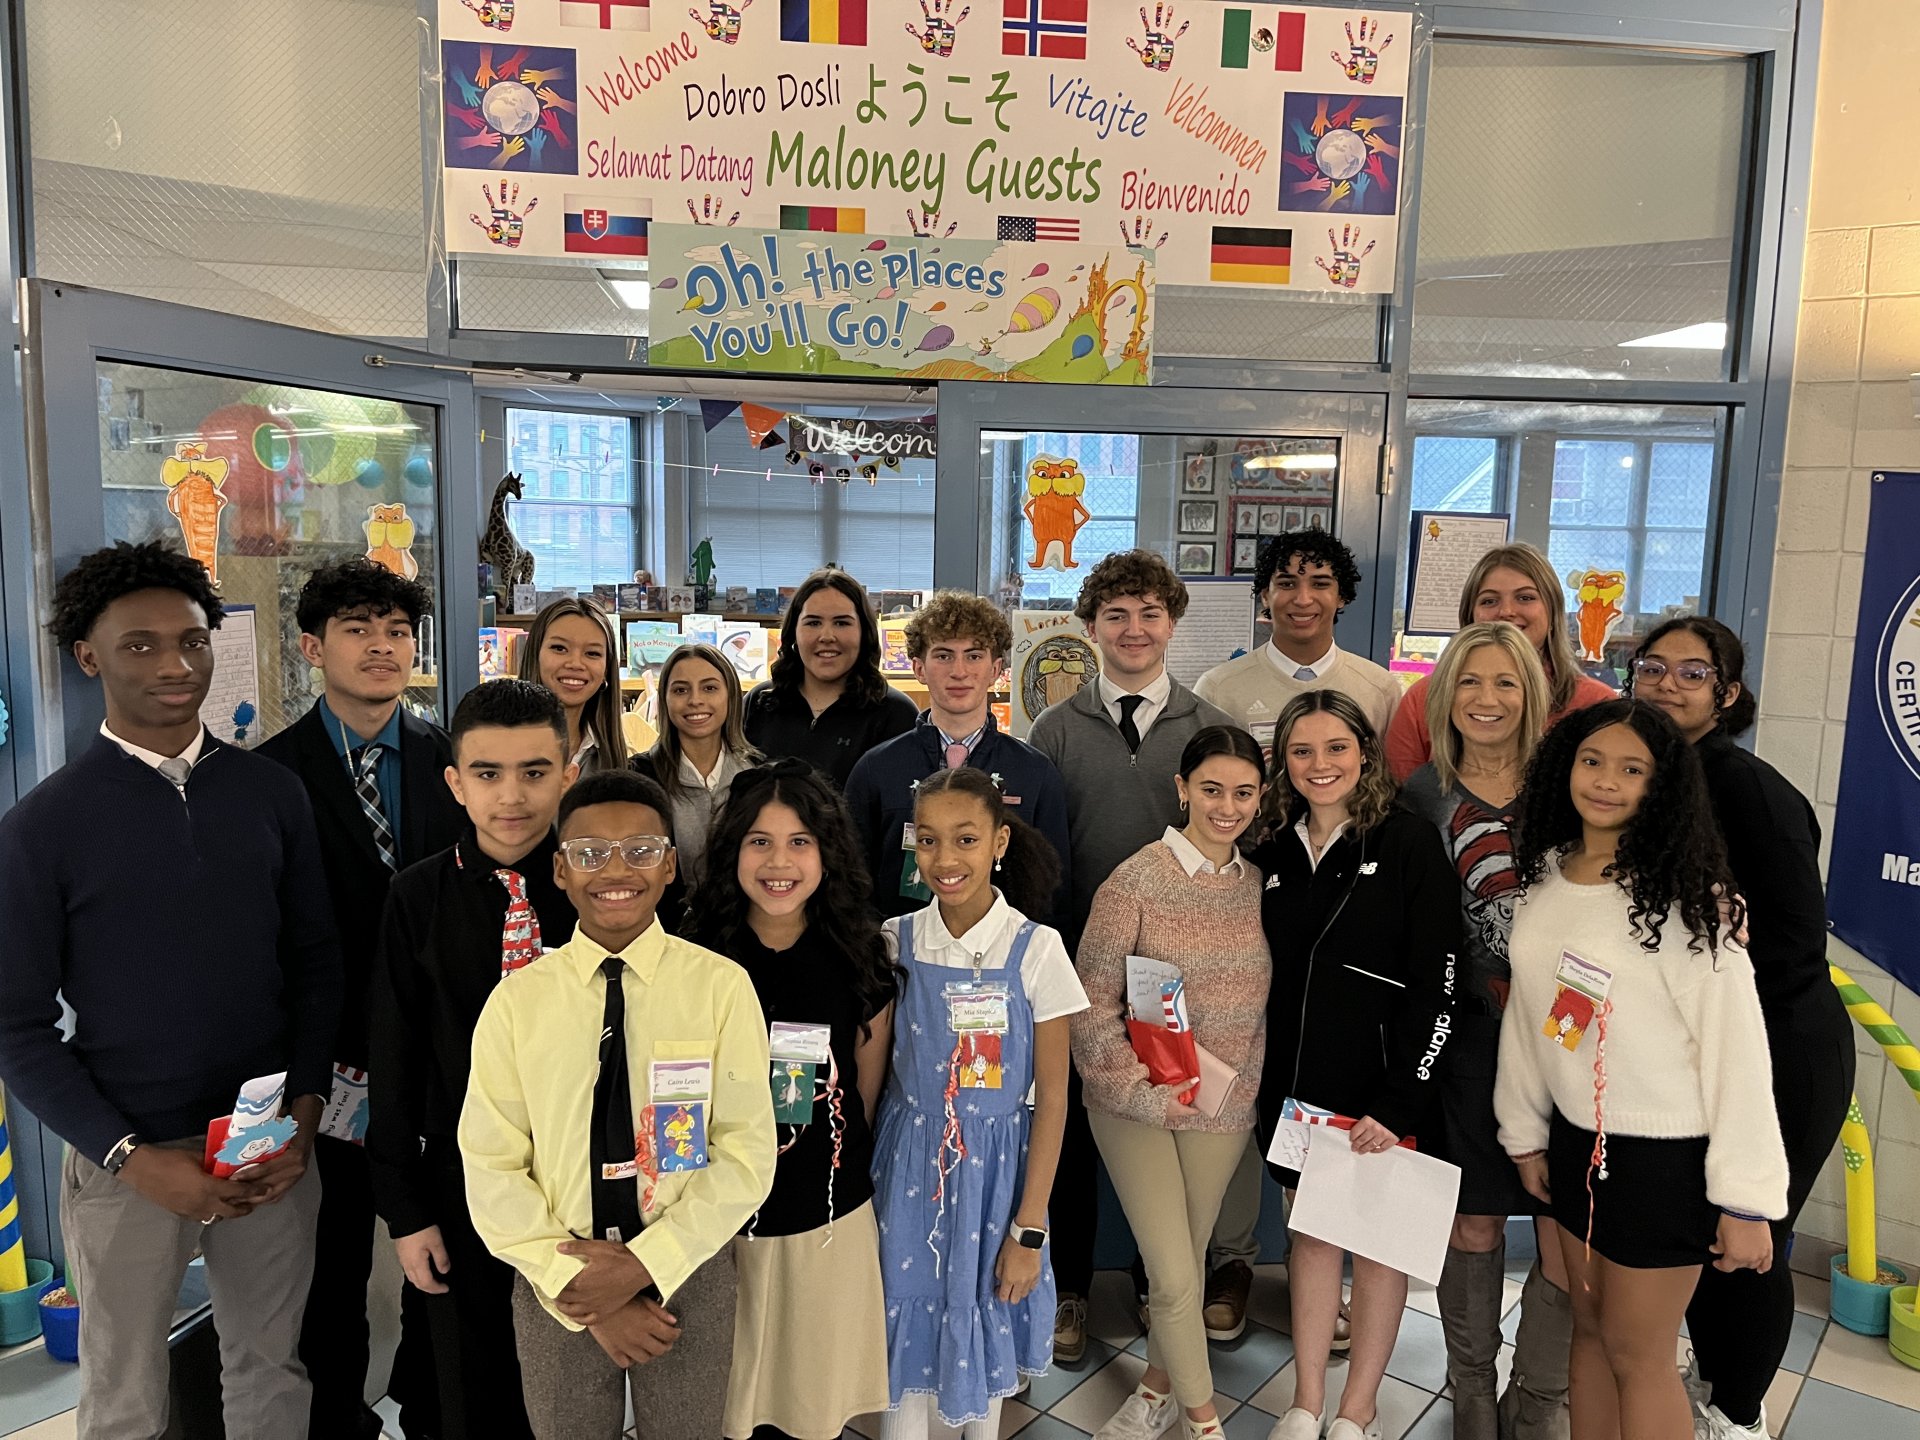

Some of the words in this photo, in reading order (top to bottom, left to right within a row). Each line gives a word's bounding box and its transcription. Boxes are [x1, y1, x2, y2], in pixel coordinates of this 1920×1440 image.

[585, 31, 698, 115] Welcome
[684, 73, 766, 121] Dobro
[777, 64, 841, 111] Dosli
[857, 63, 1018, 132] ようこそ
[1049, 74, 1148, 140] Vitajte
[1164, 77, 1267, 174] Velcommen
[587, 138, 672, 181] Selamat
[681, 145, 754, 197] Datang
[766, 125, 946, 213] Maloney
[967, 138, 1102, 204] Guests
[1121, 168, 1251, 217] Bienvenido
[686, 235, 785, 315] Oh!
[802, 246, 874, 299] the
[881, 248, 1007, 297] Places
[690, 300, 810, 361] You'll
[828, 300, 911, 348] Go!
[802, 420, 936, 456] Welcom
[1416, 1009, 1453, 1081] alance
